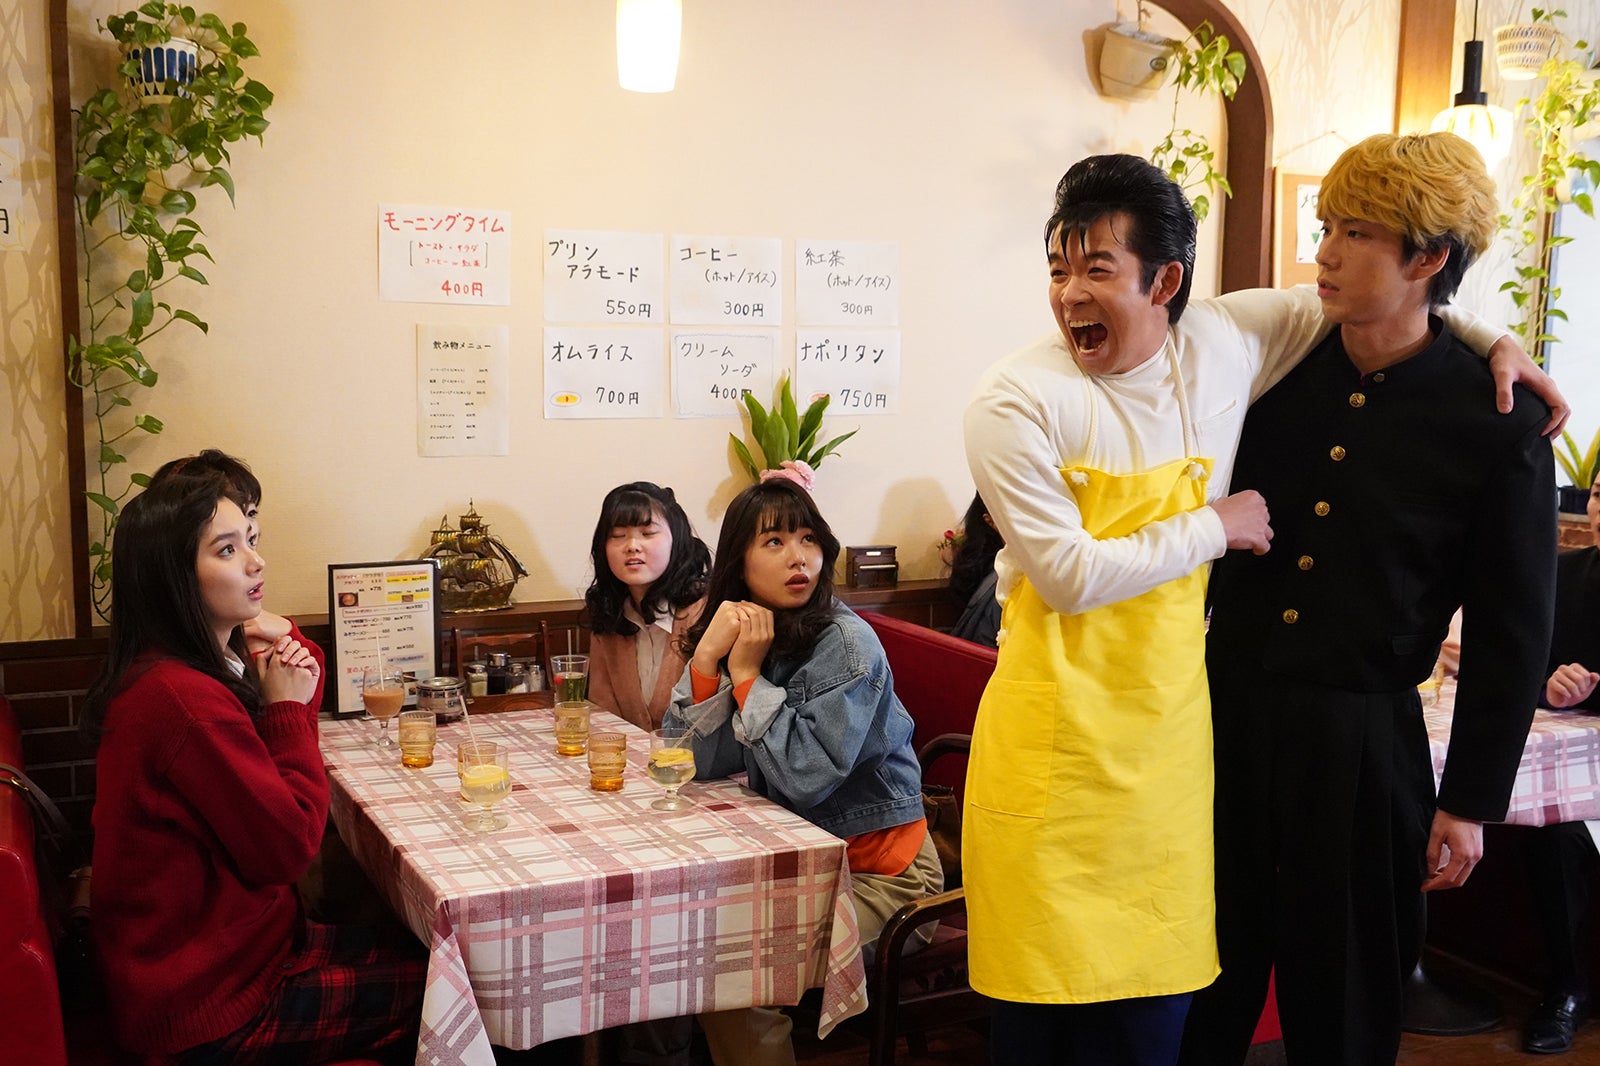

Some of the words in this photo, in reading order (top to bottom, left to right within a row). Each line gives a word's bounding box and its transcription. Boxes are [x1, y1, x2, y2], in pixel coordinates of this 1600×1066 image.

[384, 212, 504, 232] モーニングタイム
[548, 239, 598, 261] プリン
[680, 247, 737, 261] コーヒー
[805, 247, 846, 267] 紅茶
[567, 264, 639, 283] アラモード
[441, 280, 483, 297] 400円
[606, 299, 651, 318] 550円
[724, 301, 764, 317] 300円
[841, 302, 873, 315] 300円
[433, 340, 491, 350] 飲み物メニュー
[551, 341, 633, 362] オムライス
[680, 342, 734, 358] クリーム
[801, 338, 884, 364] ナポリタン
[720, 362, 758, 378] ソーダ
[596, 386, 639, 405] 700円
[840, 388, 887, 408] 750円
